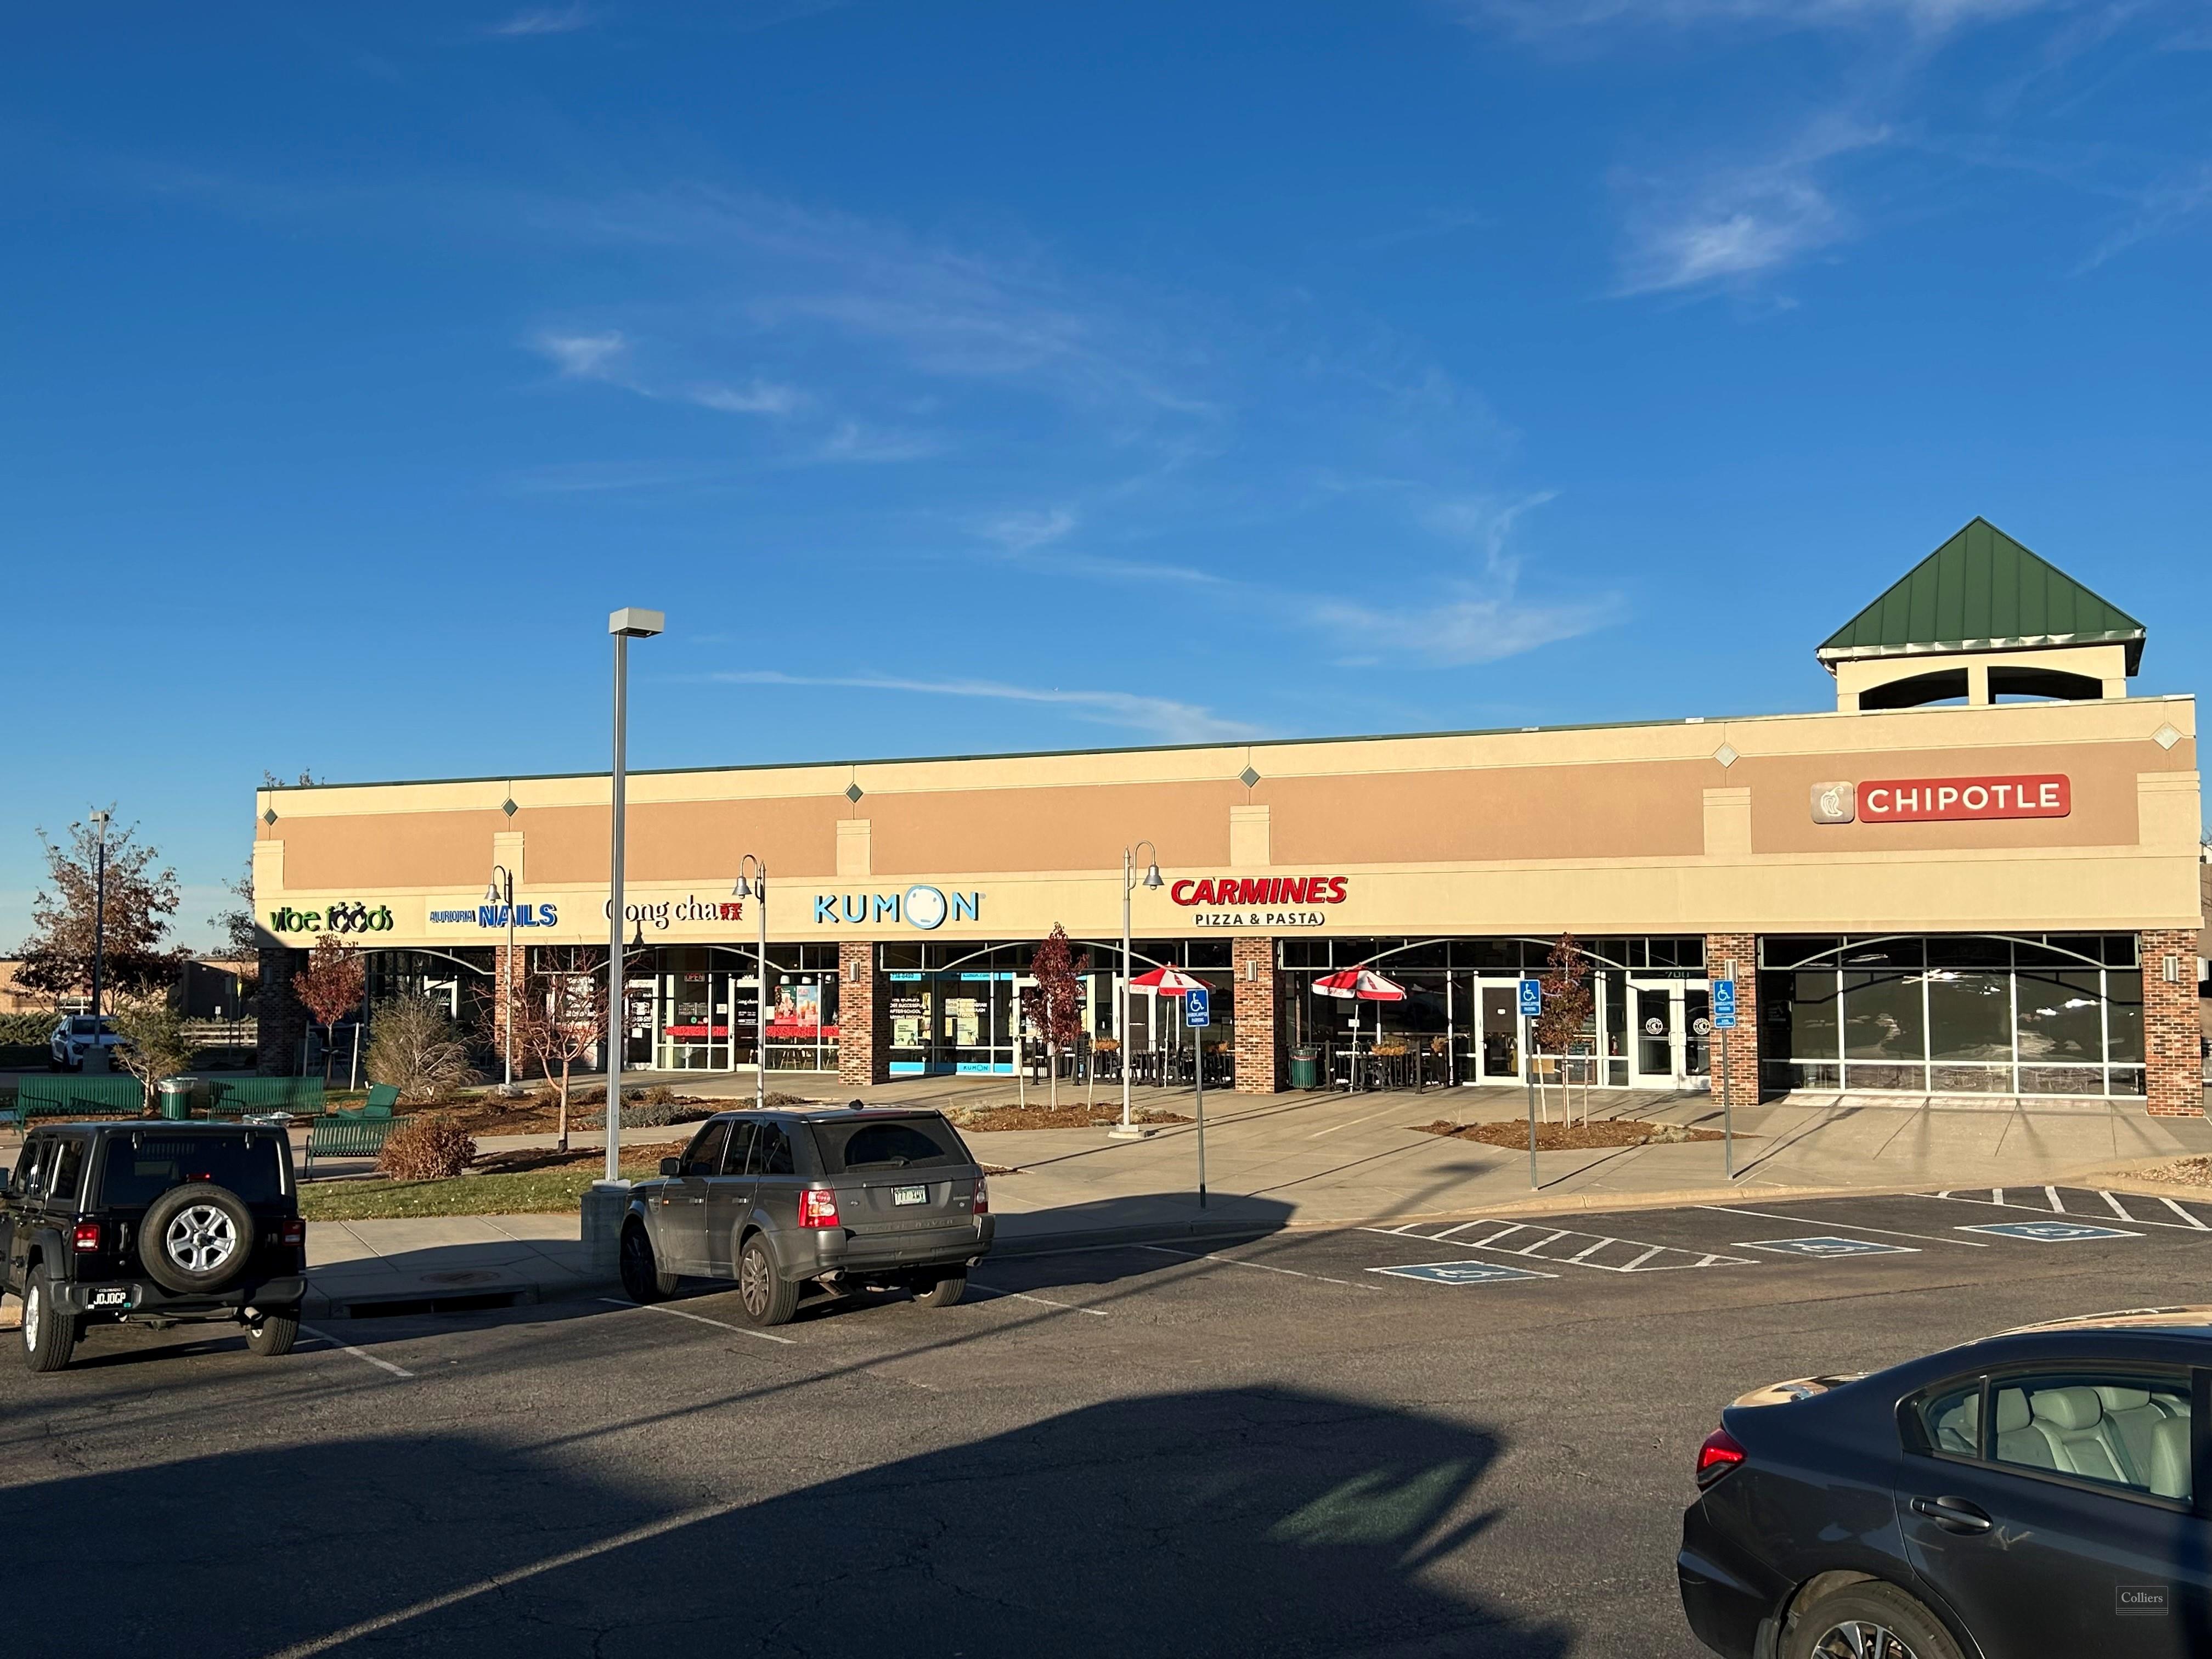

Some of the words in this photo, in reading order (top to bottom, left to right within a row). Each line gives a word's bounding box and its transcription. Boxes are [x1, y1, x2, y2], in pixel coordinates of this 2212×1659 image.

[1866, 782, 2061, 814] CHIPOTLE
[1171, 876, 1348, 906] CARMINES
[269, 907, 320, 932] vibe
[430, 910, 476, 923] AURORA
[478, 904, 557, 928] NAILS
[673, 895, 719, 921] cha
[814, 885, 979, 930] KUMON
[1195, 913, 1244, 925] PIZZA
[1250, 913, 1260, 924] &
[1266, 912, 1318, 924] PASTA
